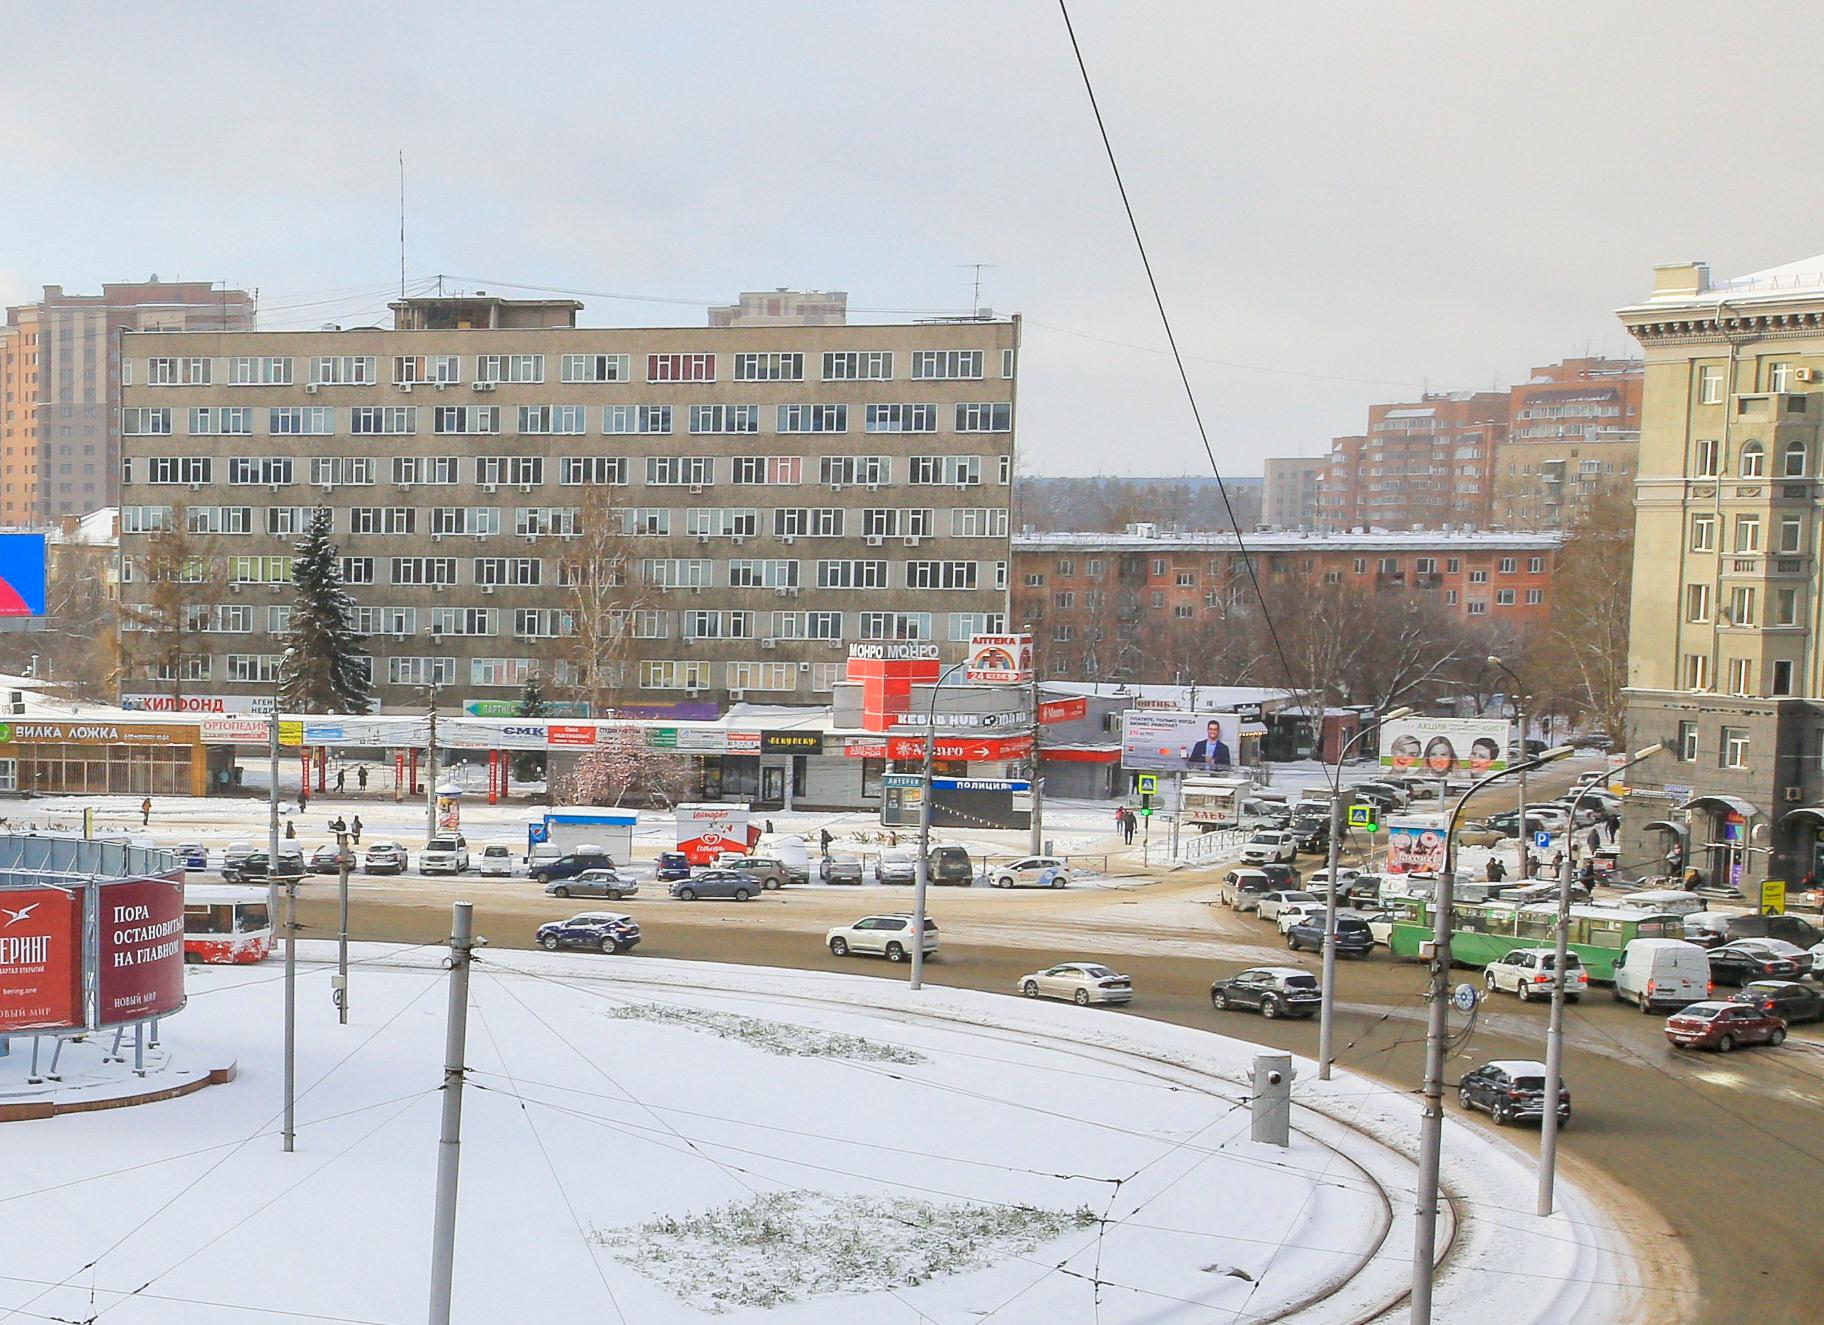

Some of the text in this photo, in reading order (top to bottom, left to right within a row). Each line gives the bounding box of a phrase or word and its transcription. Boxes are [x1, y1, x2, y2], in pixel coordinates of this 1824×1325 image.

[972, 636, 1017, 646] АПТЕКА
[850, 643, 884, 659] МОНРО
[887, 644, 939, 659] МОНРО
[971, 671, 984, 681] 24
[1137, 700, 1179, 709] ОПТИКА
[949, 714, 978, 725] HUB
[203, 721, 267, 731] ОРТОПЕДИЯ
[1417, 723, 1447, 731] АКЦИЯ
[15, 725, 62, 739] ВИЛКА
[68, 726, 119, 740] ЛОЖКА
[956, 781, 1008, 791] ПОЛИЦИЯ
[1192, 811, 1226, 820] ХЛЕБ
[113, 905, 150, 924] ПОРА
[113, 940, 179, 968] НА ГЛАВНОМ
[2, 986, 38, 996] bering.one
[113, 990, 157, 1008] НОВЫЙ МИР
[30, 1007, 51, 1017] МИР
